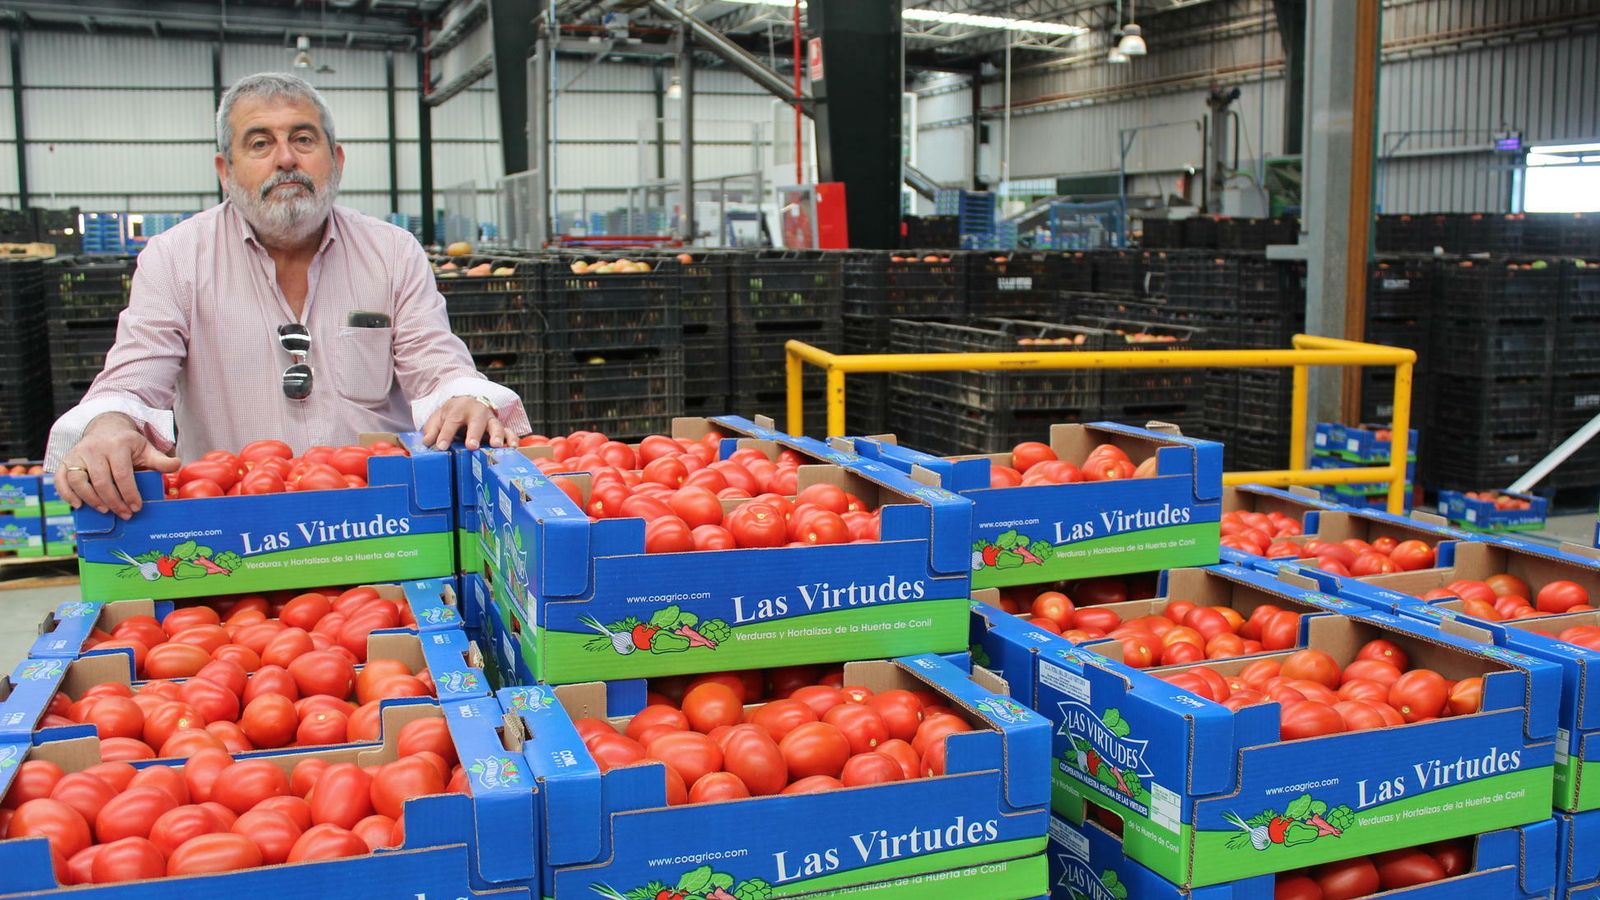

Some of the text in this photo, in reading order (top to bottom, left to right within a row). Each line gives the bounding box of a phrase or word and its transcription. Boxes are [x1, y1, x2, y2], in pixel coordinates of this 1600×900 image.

[240, 513, 410, 555] Las Virtudes
[979, 517, 1040, 529] www.coagrico.com
[1054, 503, 1191, 545] Las Virtudes
[150, 528, 222, 541] www.coagrico.com
[246, 560, 281, 570] Verduras
[282, 560, 289, 568] y
[290, 556, 330, 566] Hortalizas
[332, 555, 344, 563] de
[345, 554, 353, 562] la
[355, 551, 382, 561] Huerta
[398, 549, 418, 558] Conil
[1056, 538, 1196, 559] Verduras y Hortalizas de la Huerta de Conil
[626, 591, 711, 605] www.coagrico.com
[731, 575, 925, 624] Las Virtudes
[735, 617, 932, 641] Verduras y Hortalizas de la Huerta de Conil
[1068, 710, 1138, 769] LAS VIRTUDES
[560, 749, 578, 767] CONIL
[1265, 775, 1340, 796] www.coagrico.com
[1356, 747, 1521, 809] Las Virtudes
[1357, 788, 1525, 827] Verduras y Hortalizas de la Huerta de Conil
[648, 847, 748, 868] www.coagrico.com
[772, 846, 840, 883] Las
[849, 815, 1000, 864] Virtudes
[964, 867, 977, 876] de
[981, 862, 1007, 874] Conil
[1068, 864, 1085, 887] LAS
